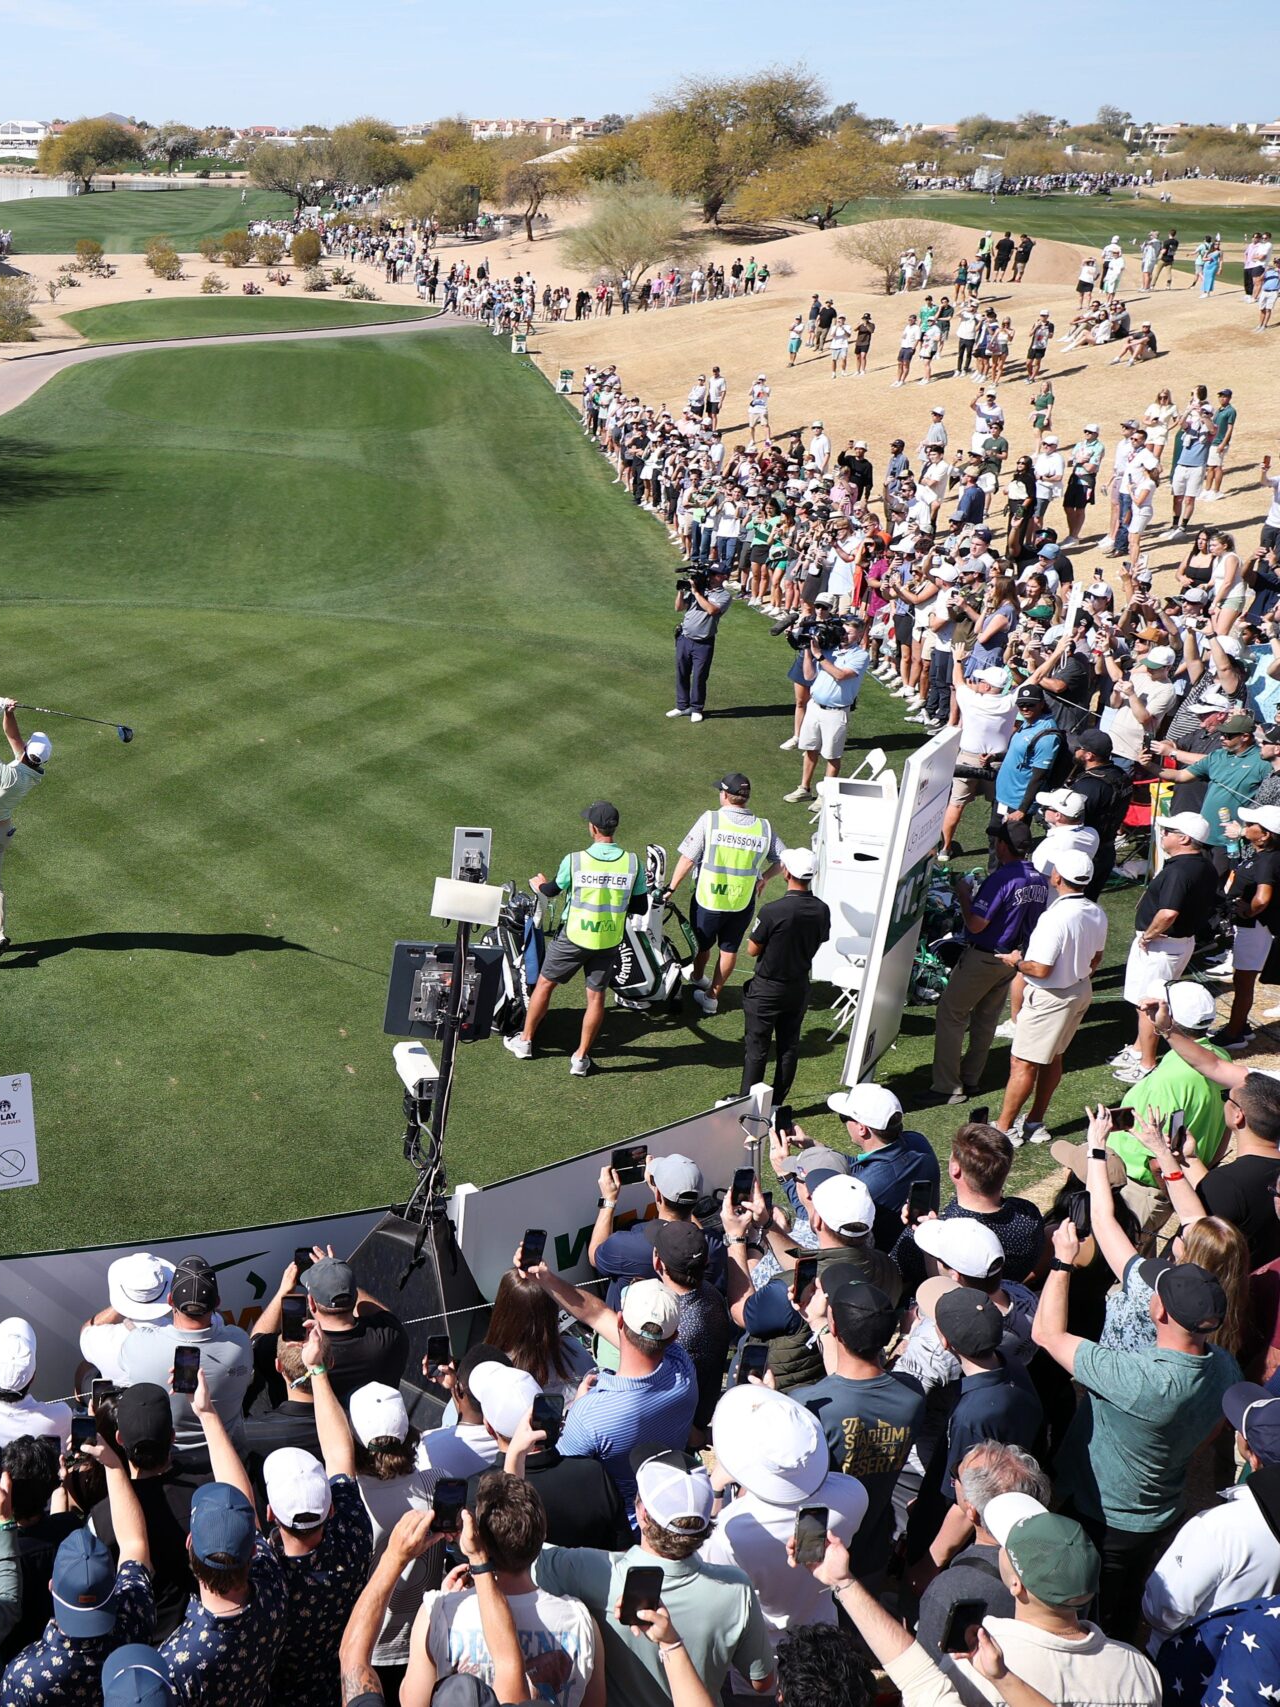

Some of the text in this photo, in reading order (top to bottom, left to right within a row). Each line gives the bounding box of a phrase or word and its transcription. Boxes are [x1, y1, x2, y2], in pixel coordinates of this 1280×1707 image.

[581, 874, 627, 886] SCHEFFLER
[580, 918, 616, 933] WM
[448, 1627, 581, 1664] DEEND
